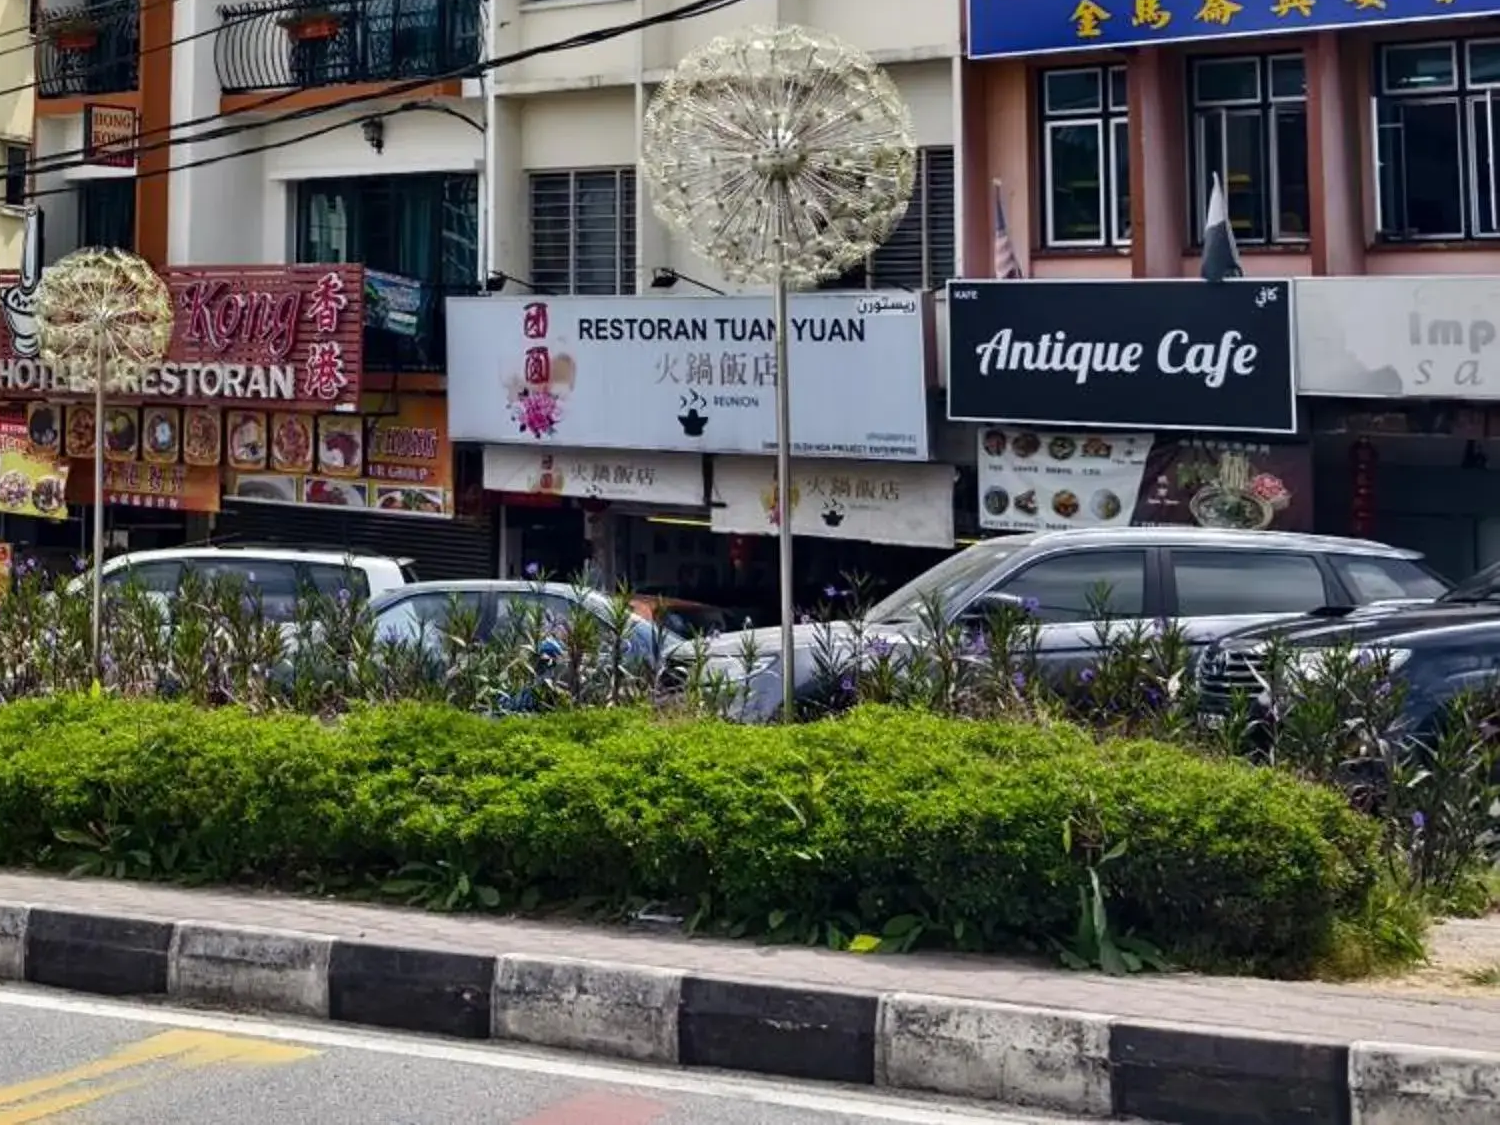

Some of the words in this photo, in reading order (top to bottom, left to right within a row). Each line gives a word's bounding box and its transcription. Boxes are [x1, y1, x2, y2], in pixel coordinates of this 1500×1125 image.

[180, 279, 301, 358] Kong
[954, 290, 978, 300] KAFE
[304, 271, 349, 401] 香港
[578, 318, 707, 341] RESTORAN
[790, 319, 865, 343] YUAN
[976, 328, 1143, 384] Antique
[1157, 330, 1258, 388] Cafe
